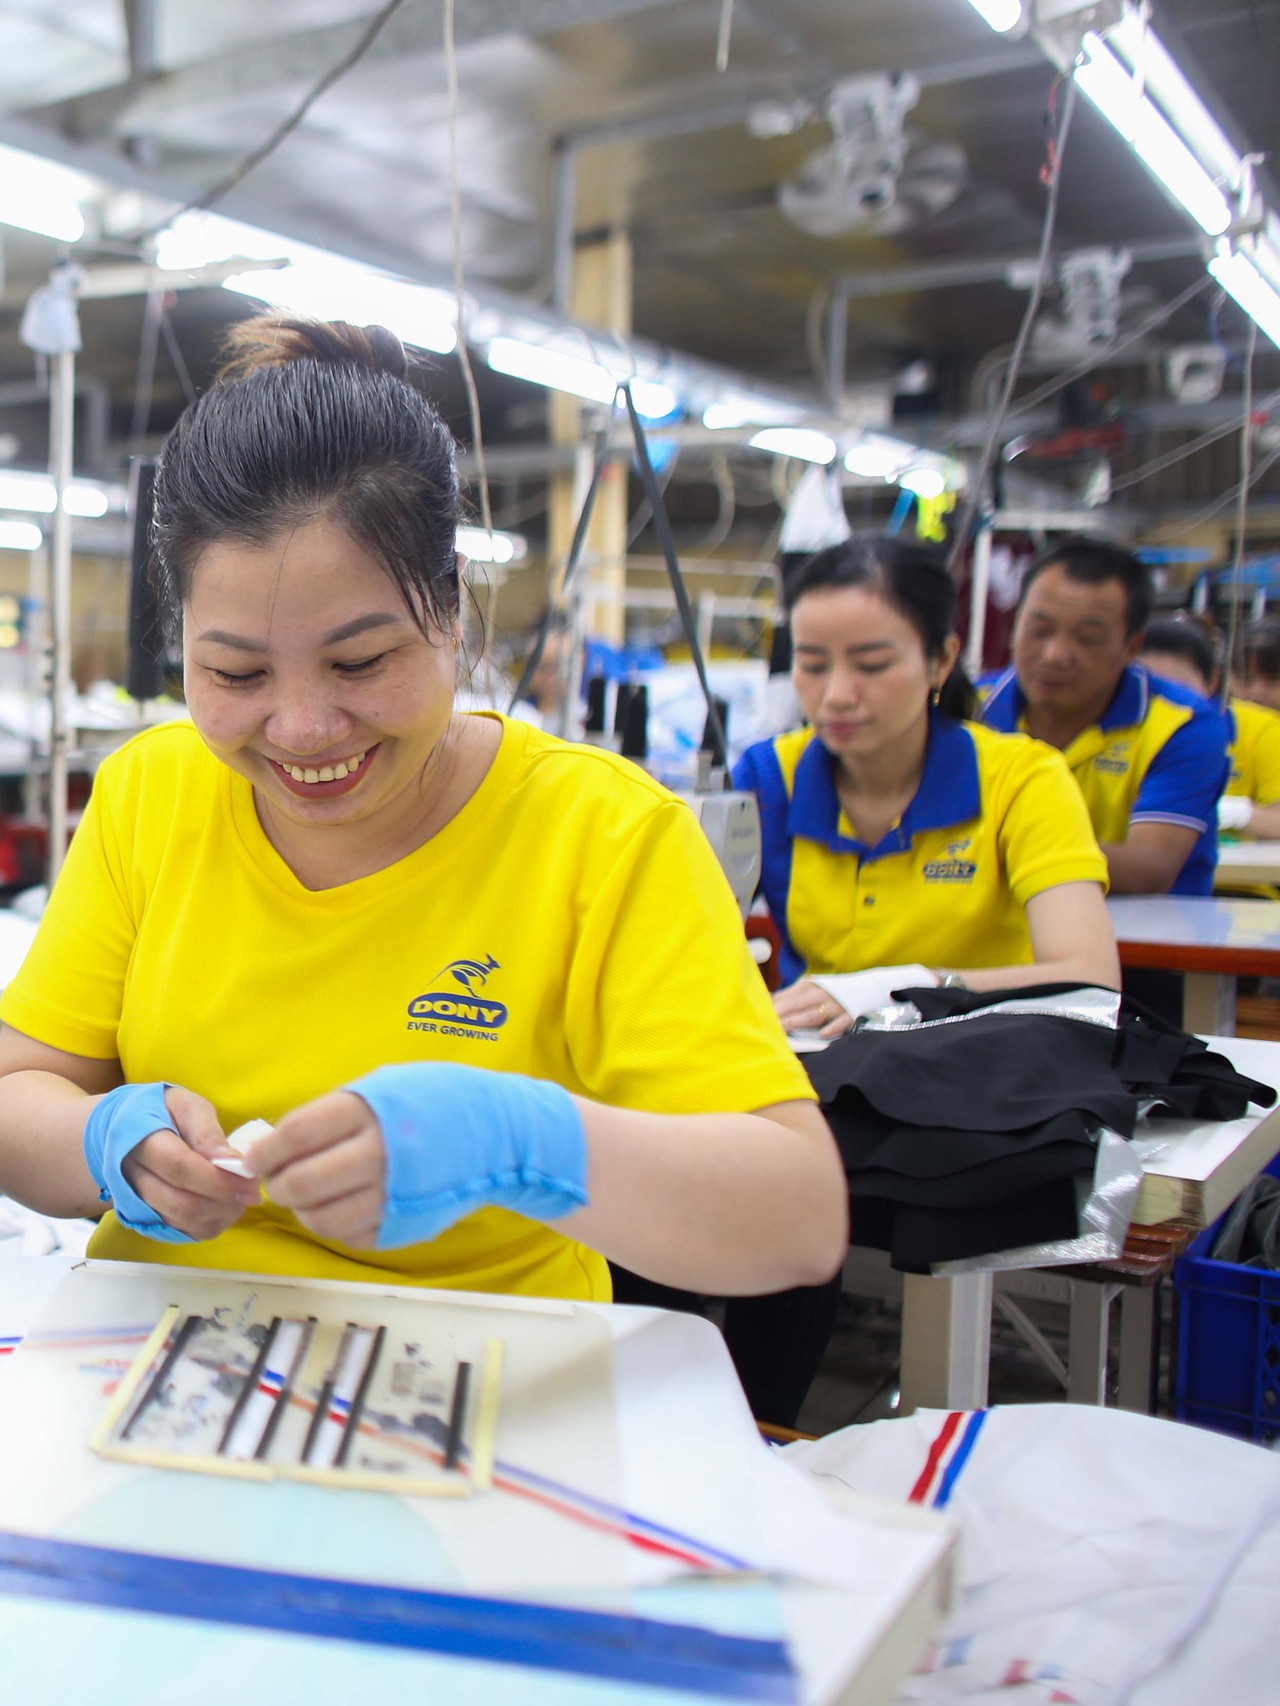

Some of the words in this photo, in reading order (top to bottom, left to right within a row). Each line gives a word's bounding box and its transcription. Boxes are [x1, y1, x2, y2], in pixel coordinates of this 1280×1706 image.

[412, 1000, 503, 1023] DONY
[407, 1021, 438, 1033] EVER
[440, 1025, 500, 1041] GROWING
